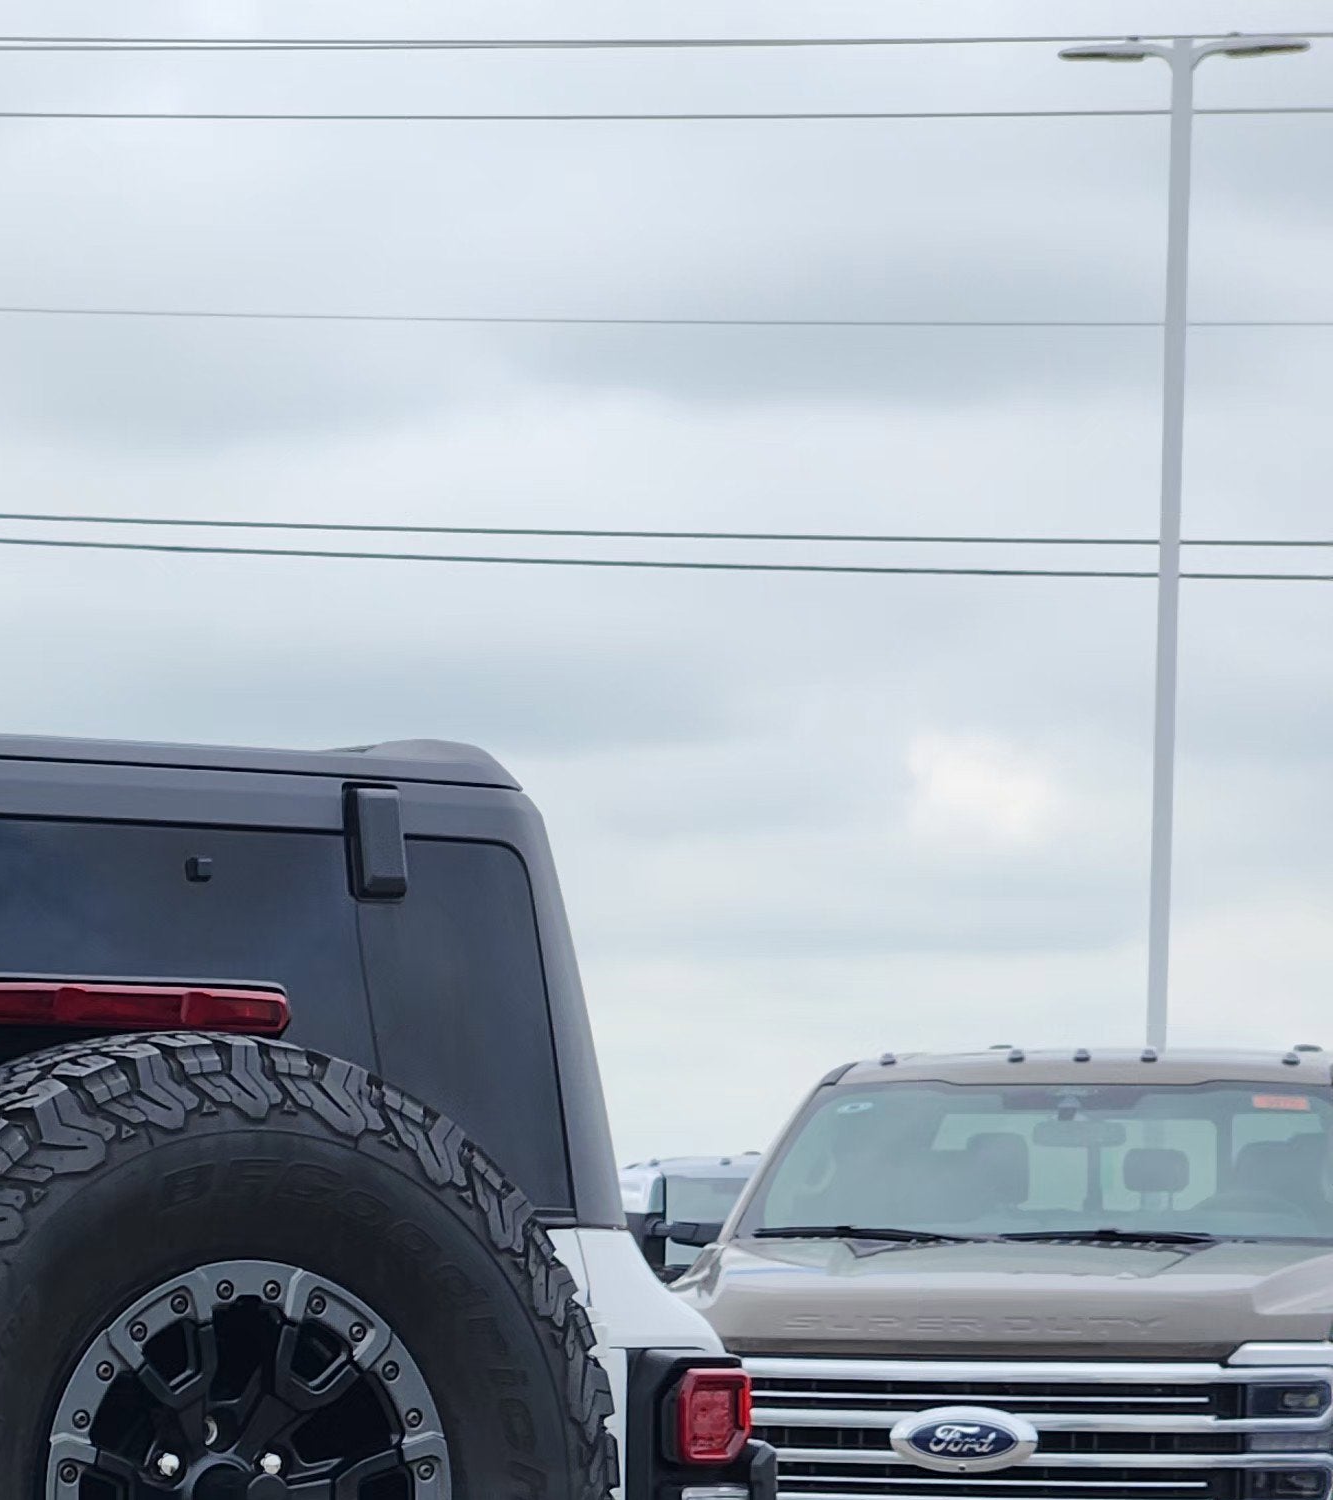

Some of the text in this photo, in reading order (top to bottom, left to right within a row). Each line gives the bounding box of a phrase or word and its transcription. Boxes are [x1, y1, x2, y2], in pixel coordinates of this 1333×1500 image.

[782, 1314, 1167, 1335] SUPER DUTY
[928, 1424, 996, 1457] Ford
